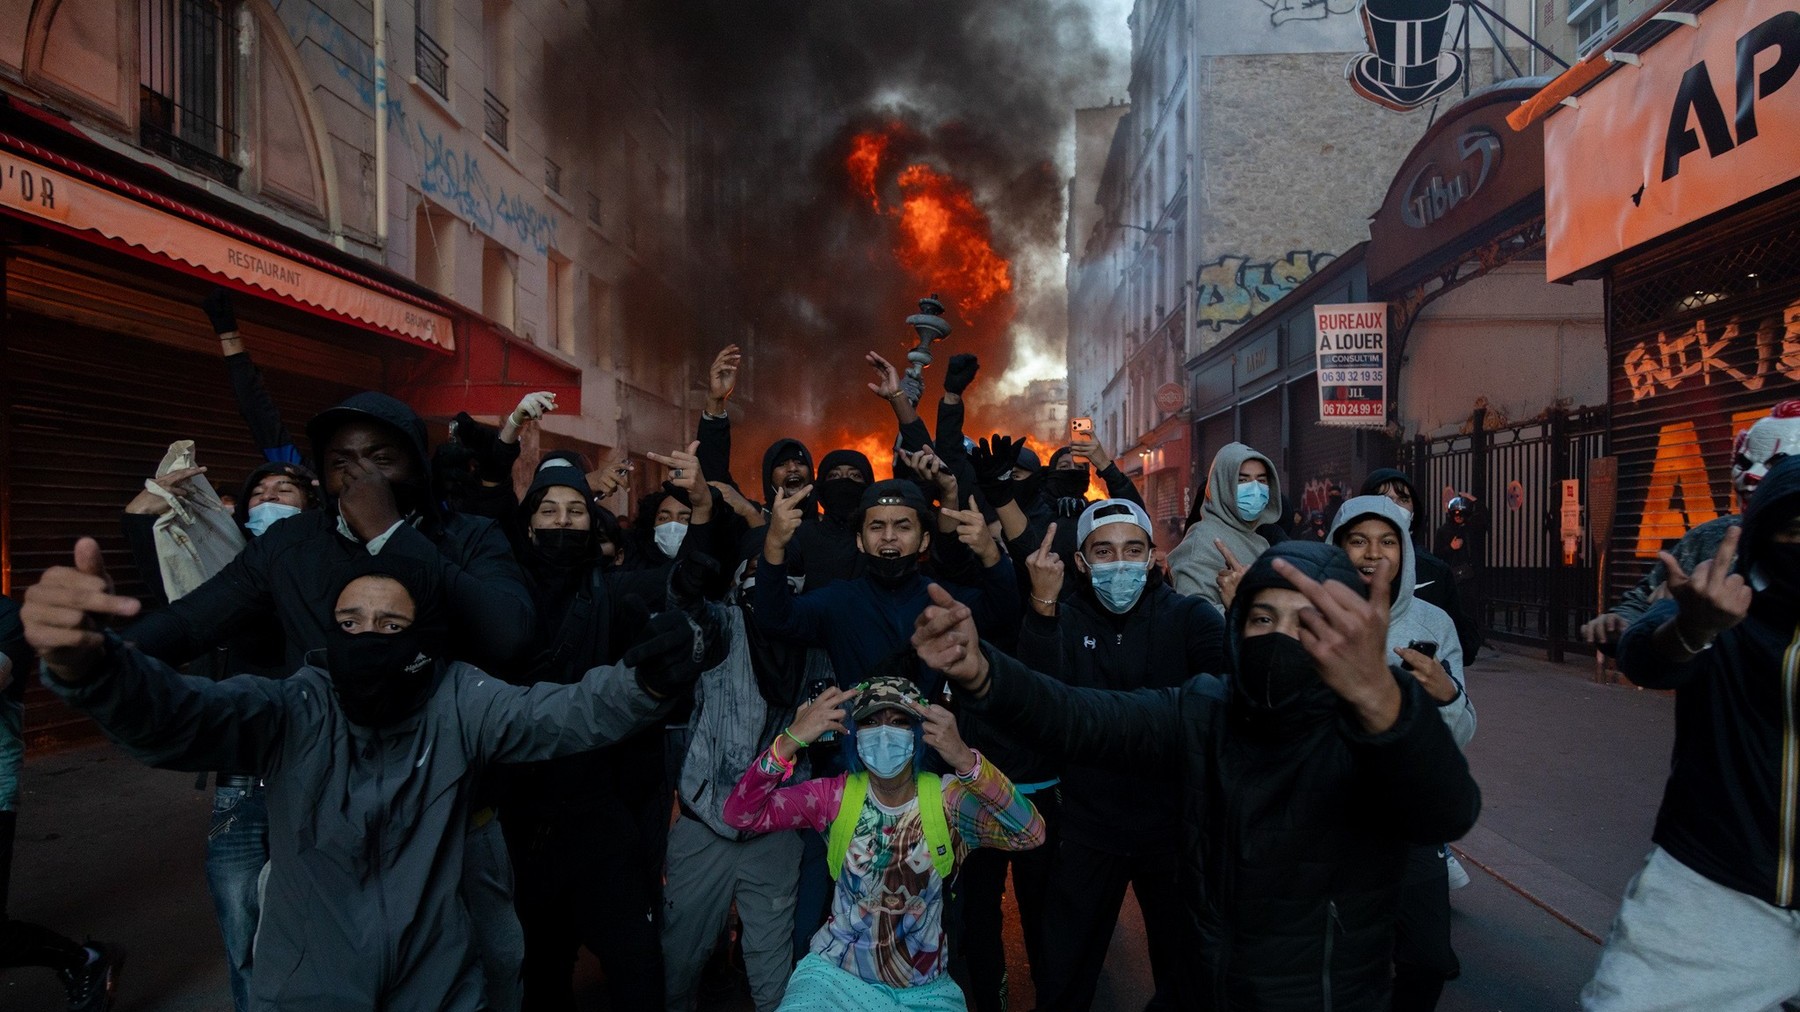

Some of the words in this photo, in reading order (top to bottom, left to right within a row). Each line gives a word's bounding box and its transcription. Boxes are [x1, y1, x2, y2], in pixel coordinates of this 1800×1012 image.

[0, 163, 55, 210] 'OR
[227, 247, 301, 287] RESTAURANT
[405, 311, 436, 332] BRUNCH
[1319, 312, 1382, 330] BUREAUX
[1320, 331, 1332, 351] À
[1336, 333, 1383, 350] LOUER
[1322, 371, 1333, 382] 06
[1335, 371, 1345, 382] 30
[1348, 371, 1358, 381] 32
[1361, 371, 1370, 381] 19
[1372, 370, 1383, 381] 35
[1348, 387, 1364, 398] JLL
[1323, 404, 1334, 415] 06
[1335, 404, 1346, 415] 70
[1348, 404, 1358, 415] 24
[1360, 404, 1370, 415] 99
[1372, 403, 1382, 414] 12
